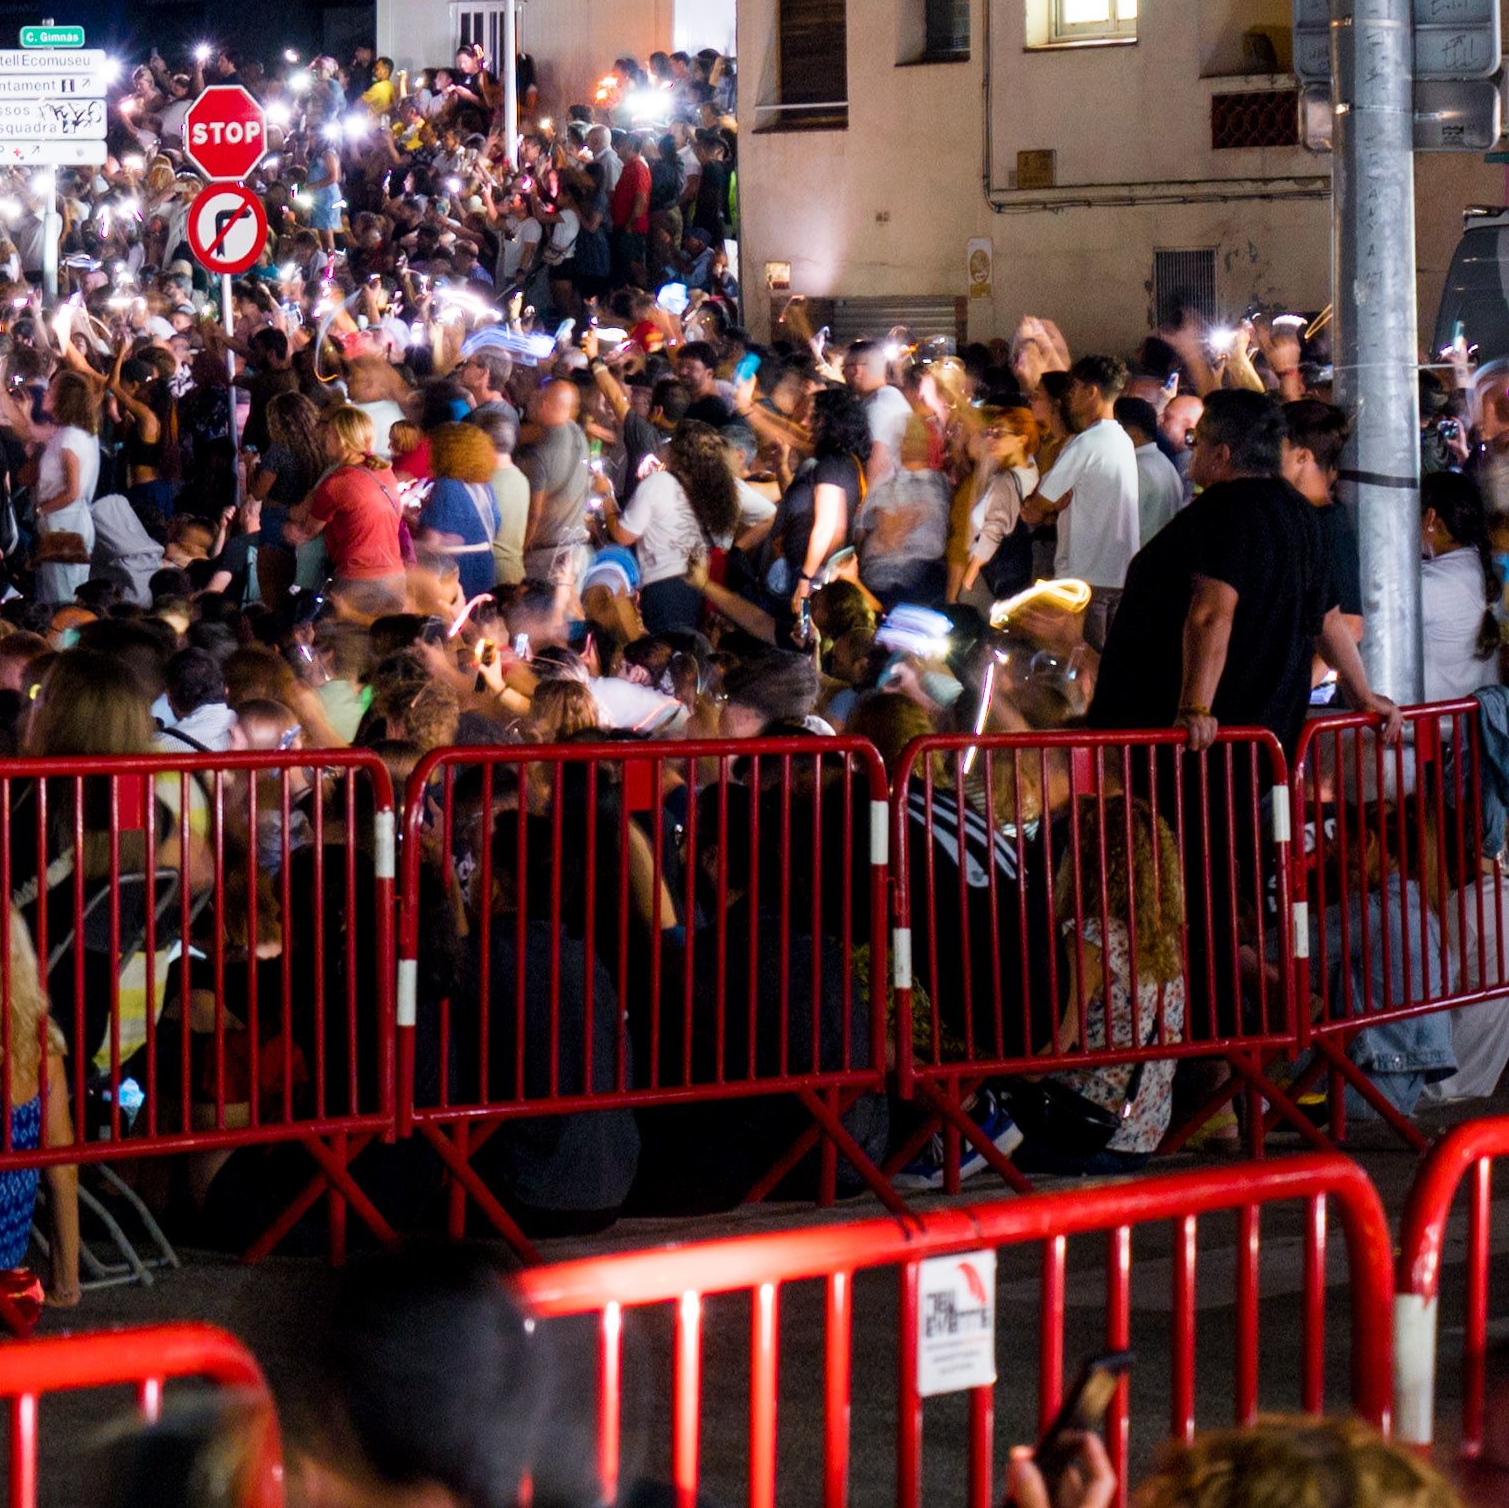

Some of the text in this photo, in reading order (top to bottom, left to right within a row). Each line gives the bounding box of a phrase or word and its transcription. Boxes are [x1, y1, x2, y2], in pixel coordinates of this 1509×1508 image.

[26, 31, 37, 42] C.
[22, 54, 90, 67] Ecomuseu
[192, 121, 261, 145] STOP
